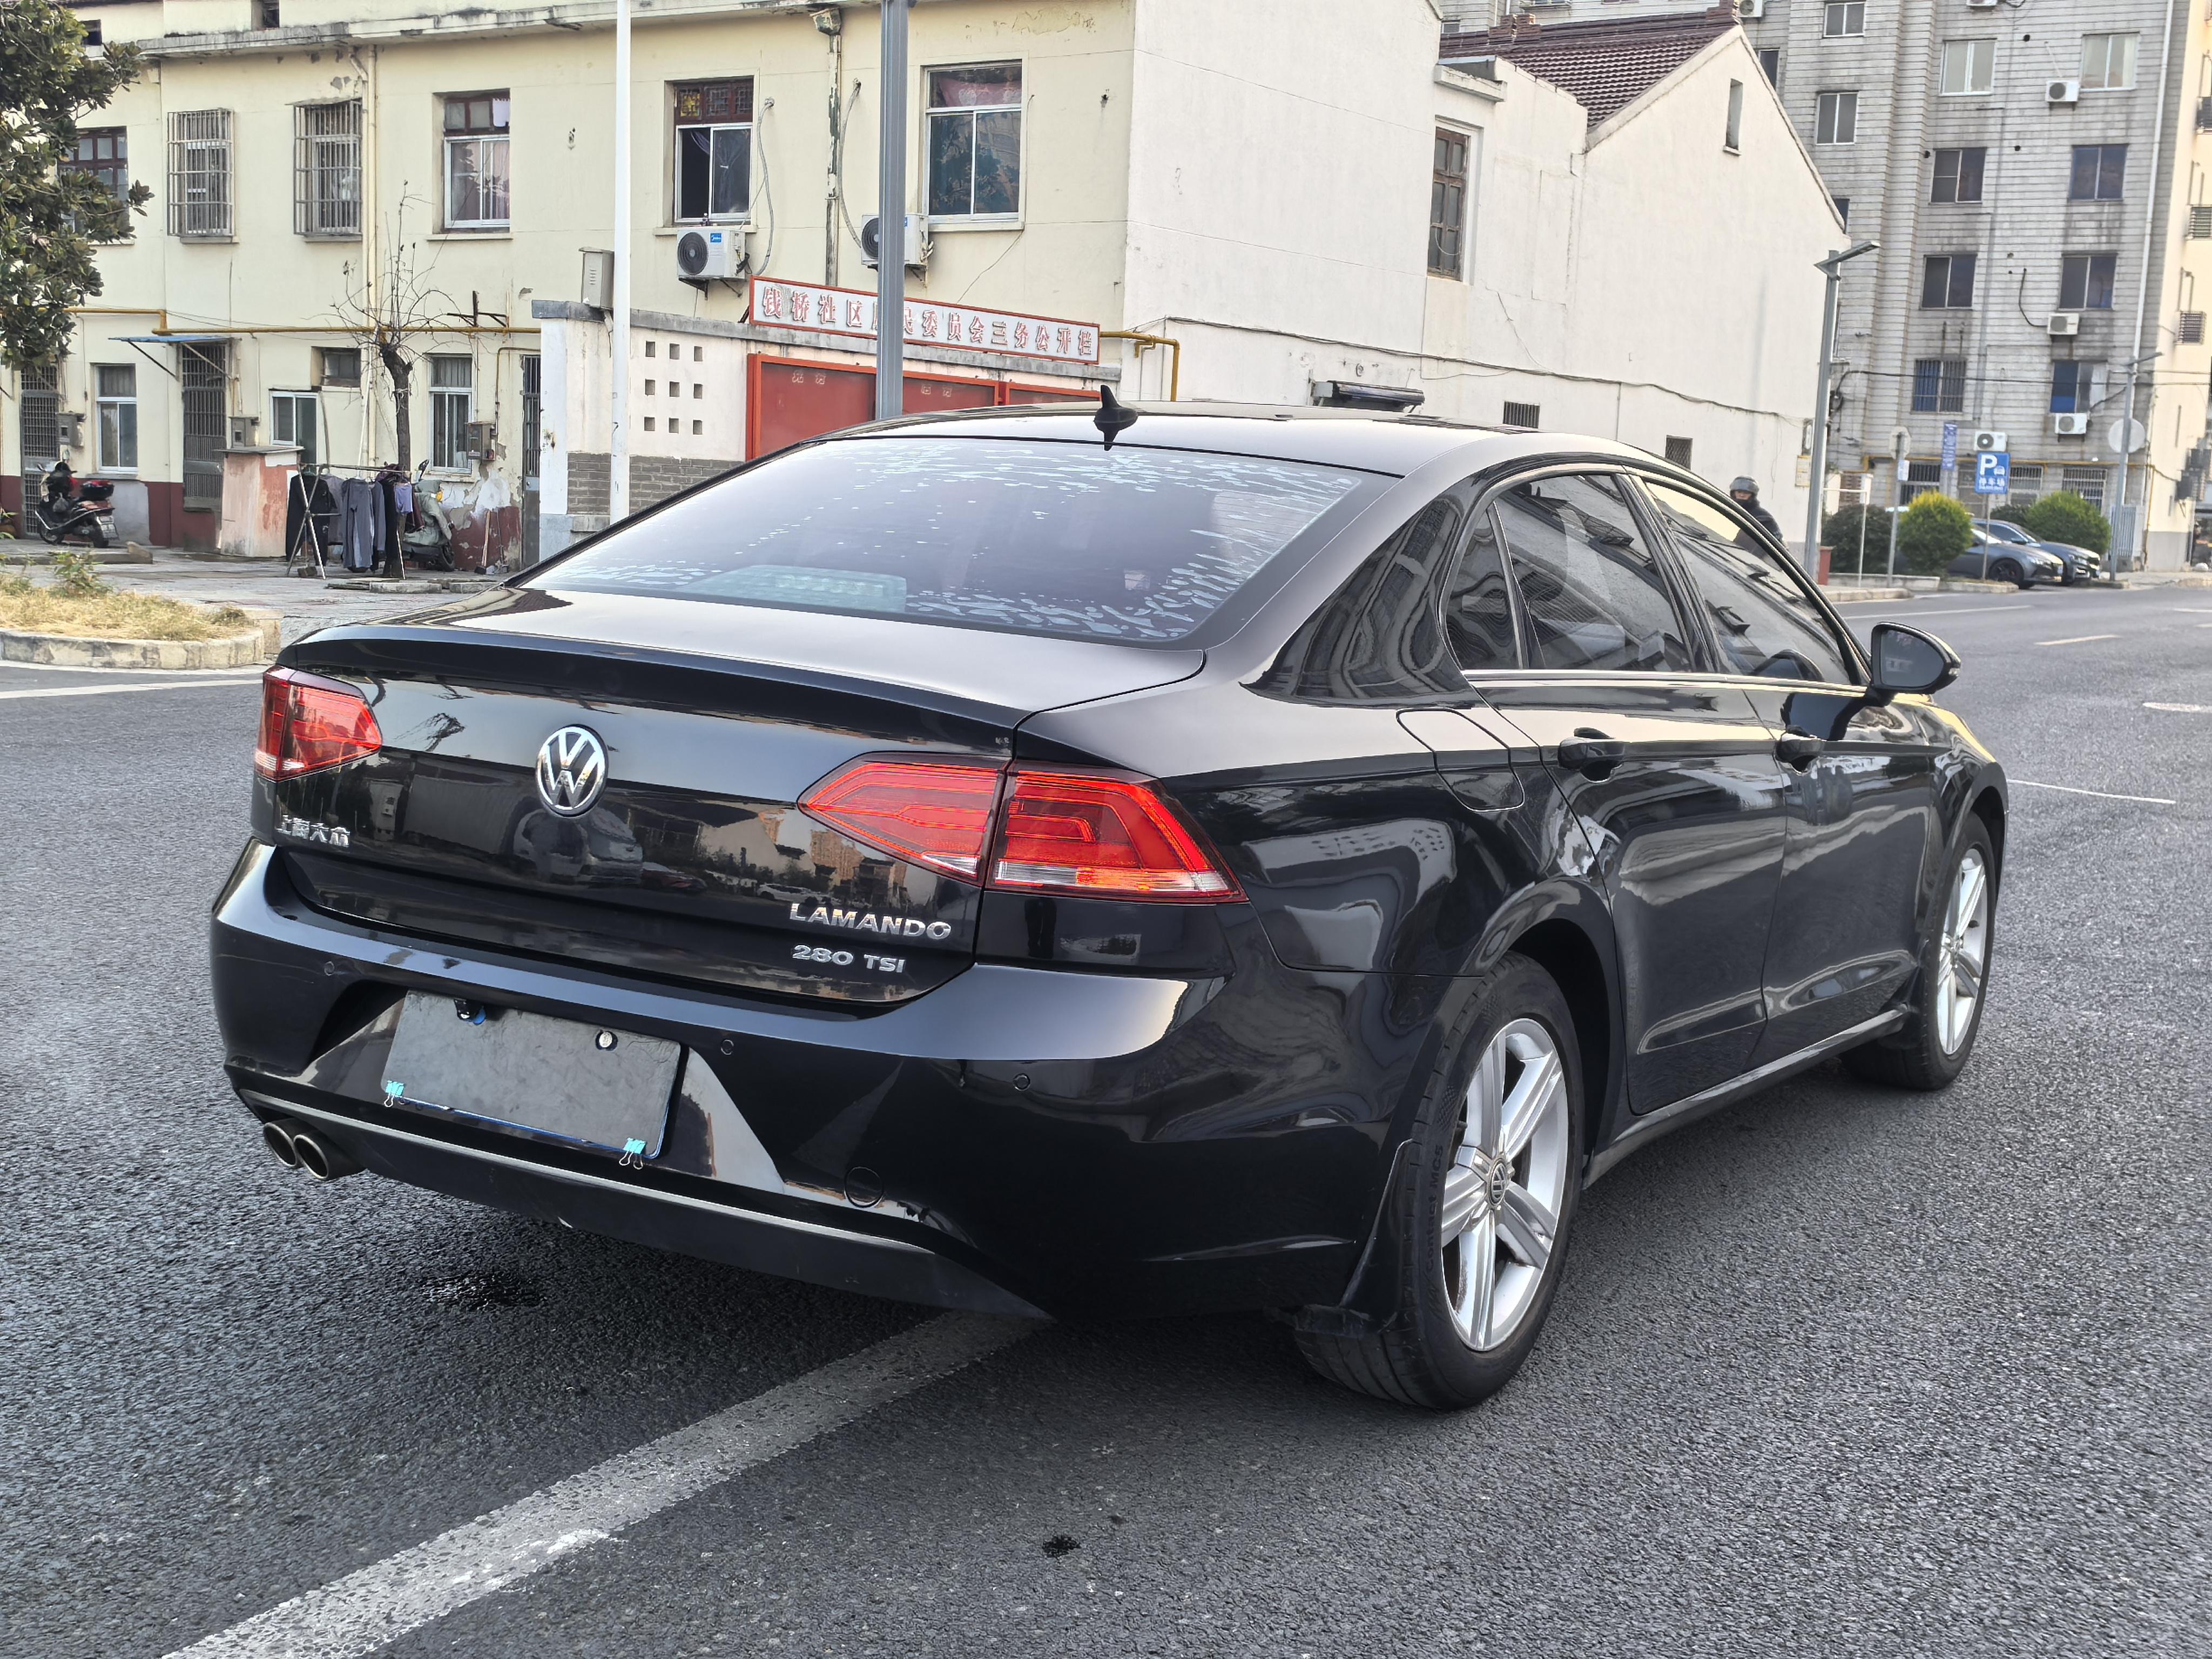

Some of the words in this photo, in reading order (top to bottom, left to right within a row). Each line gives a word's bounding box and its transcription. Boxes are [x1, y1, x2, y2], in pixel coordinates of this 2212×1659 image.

[763, 286, 1092, 356] 钱桥社区民委员会三务公开栏
[1980, 454, 1998, 475] P
[789, 903, 952, 940] LAMANDO
[792, 945, 854, 966] 280
[864, 953, 906, 973] TSI
[1429, 1144, 1444, 1189] MC5
